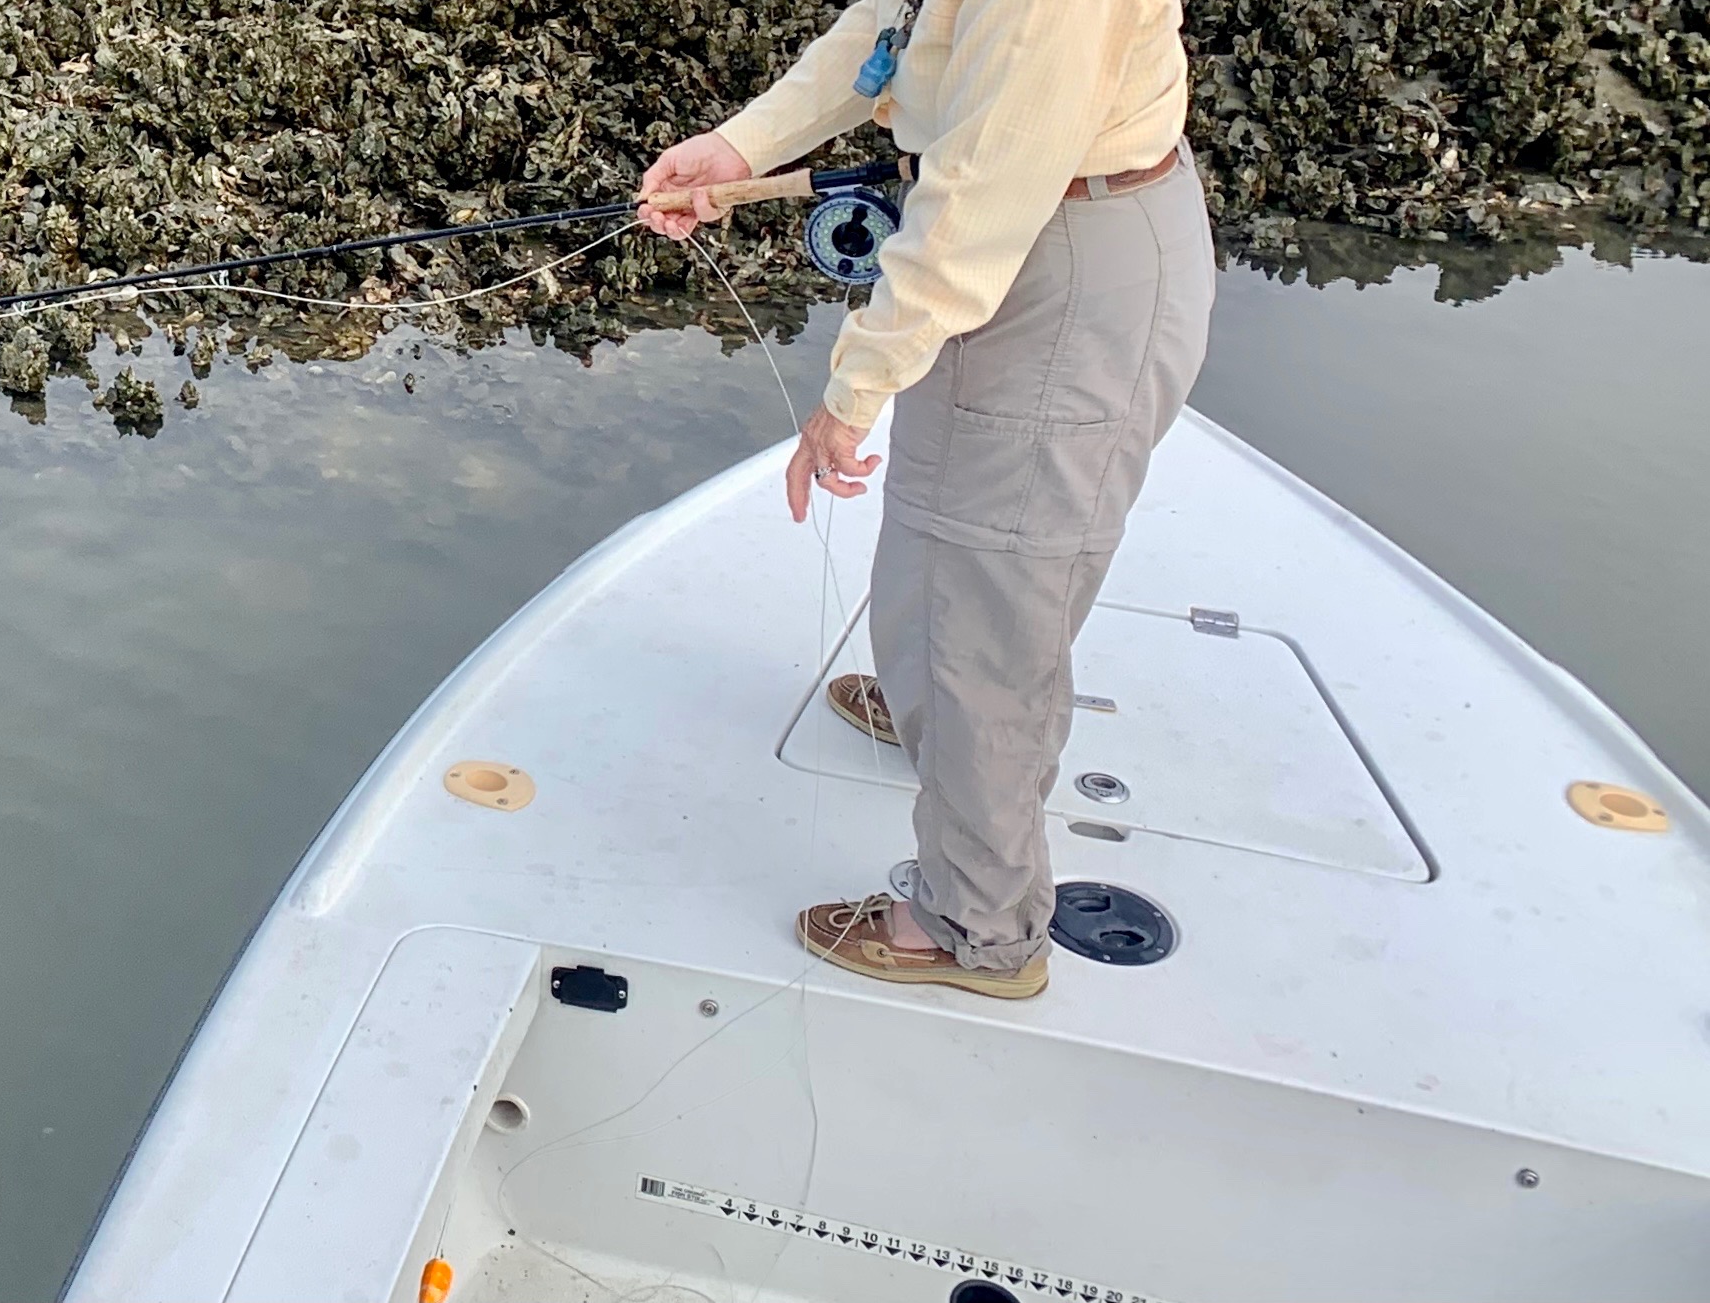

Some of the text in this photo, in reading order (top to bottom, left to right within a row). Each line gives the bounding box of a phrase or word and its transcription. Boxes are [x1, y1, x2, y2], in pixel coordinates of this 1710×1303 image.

[724, 1198, 733, 1207] 4
[748, 1204, 756, 1213] 5
[771, 1209, 779, 1218] 6
[795, 1214, 803, 1223] 7
[818, 1221, 827, 1230] 8
[842, 1227, 850, 1236] 9
[863, 1231, 878, 1243] 10
[887, 1237, 901, 1248] 11
[911, 1243, 926, 1254] 12
[935, 1249, 950, 1260] 13
[959, 1255, 974, 1266] 14
[983, 1260, 999, 1272] 15
[1008, 1266, 1024, 1277] 16
[1033, 1272, 1049, 1283] 17
[1057, 1278, 1073, 1290] 18
[1082, 1284, 1098, 1295] 19
[1106, 1290, 1123, 1302] 20
